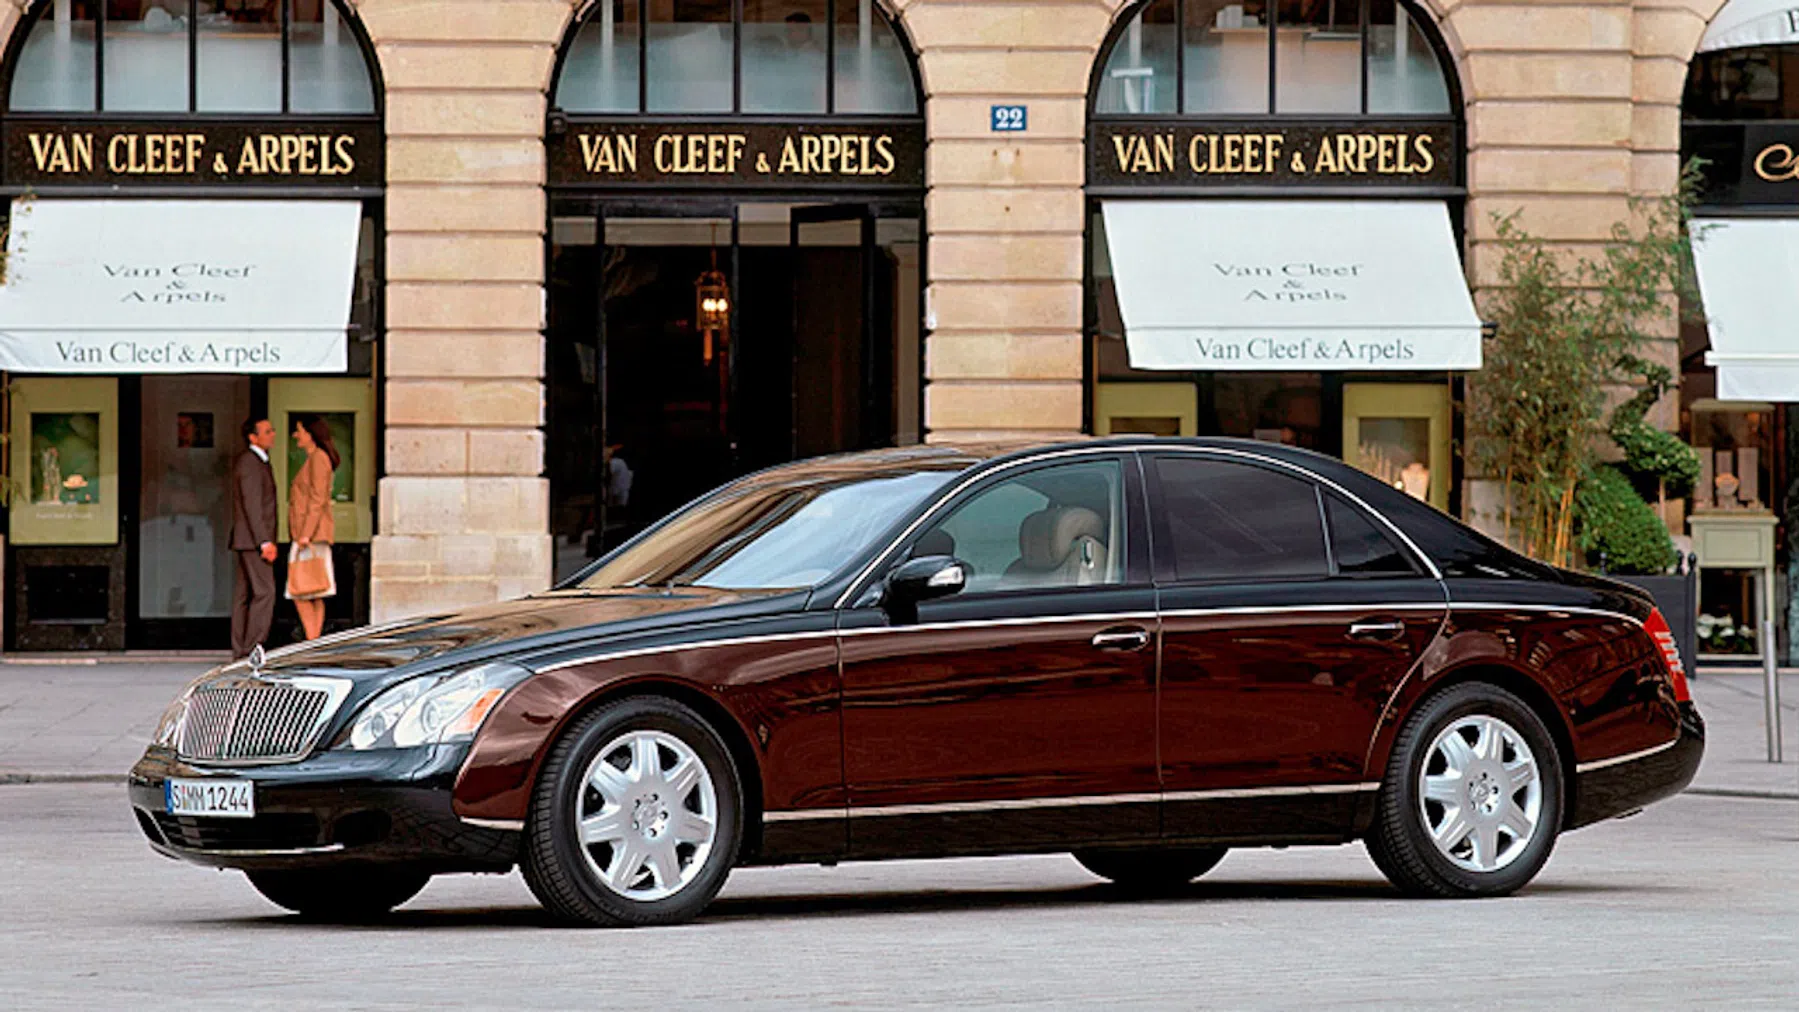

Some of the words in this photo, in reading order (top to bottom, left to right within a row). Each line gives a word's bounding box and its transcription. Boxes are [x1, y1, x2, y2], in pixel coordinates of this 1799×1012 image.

[995, 107, 1023, 129] 22
[29, 134, 93, 173] VAN
[107, 134, 206, 173] CLEEF
[213, 153, 229, 173] &
[237, 135, 355, 175] ARPELS
[578, 134, 637, 173] VAN
[654, 134, 746, 173] CLEEF
[755, 152, 770, 173] &
[778, 135, 895, 175] ARPELS
[1112, 134, 1174, 173] VAN
[1189, 134, 1284, 173] CLEEF
[1291, 152, 1306, 173] &
[1315, 134, 1434, 174] ARPELS
[103, 264, 161, 278] Van
[171, 263, 256, 278] Cleef
[1213, 263, 1271, 277] Van
[1281, 263, 1362, 277] Cleef
[166, 280, 187, 290] &
[1282, 279, 1303, 289] &
[121, 290, 226, 305] Arpels
[1244, 289, 1347, 303] Arpels
[56, 341, 103, 363] Van
[109, 341, 175, 364] Cleef
[178, 345, 194, 363] &
[200, 342, 281, 367] Arpels
[1195, 338, 1240, 360] Van
[1247, 337, 1311, 360] Cleef
[1314, 342, 1331, 359] &
[1334, 338, 1414, 364] Arpels
[207, 786, 249, 811] 1244
